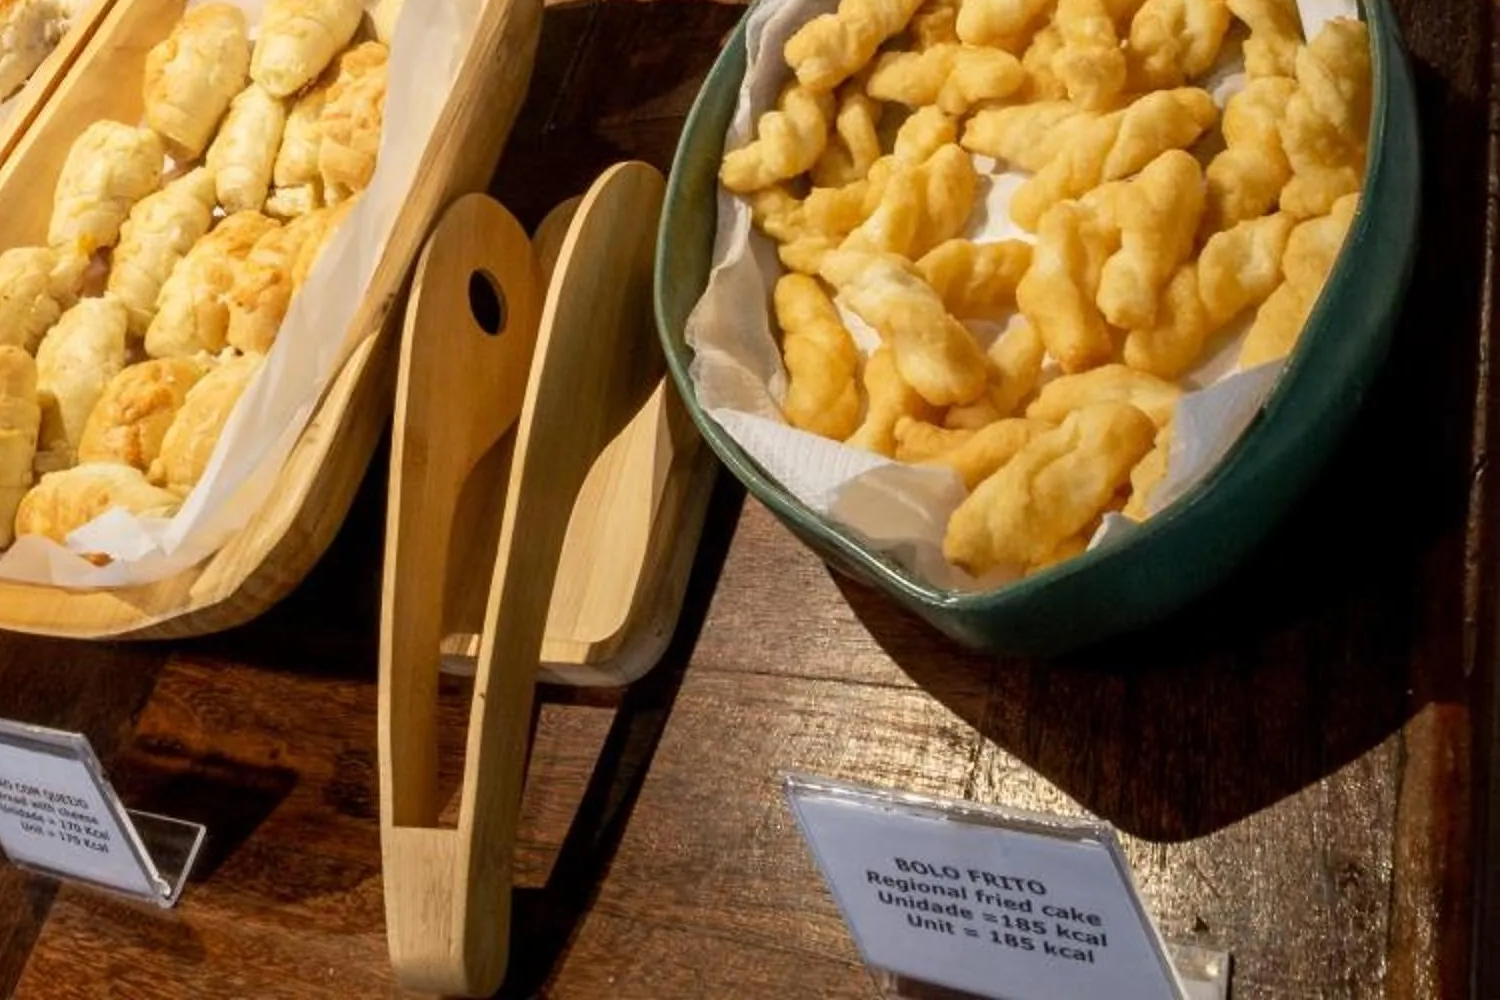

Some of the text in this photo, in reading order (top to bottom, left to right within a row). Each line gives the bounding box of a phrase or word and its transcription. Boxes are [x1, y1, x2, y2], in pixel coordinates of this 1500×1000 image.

[866, 870, 1102, 927] Regional fried cake
[894, 857, 1047, 896] BOLO FRITO
[878, 890, 974, 921] Unidade
[1056, 922, 1108, 948] kcal
[906, 912, 1095, 965] Unit = 185 kcal
